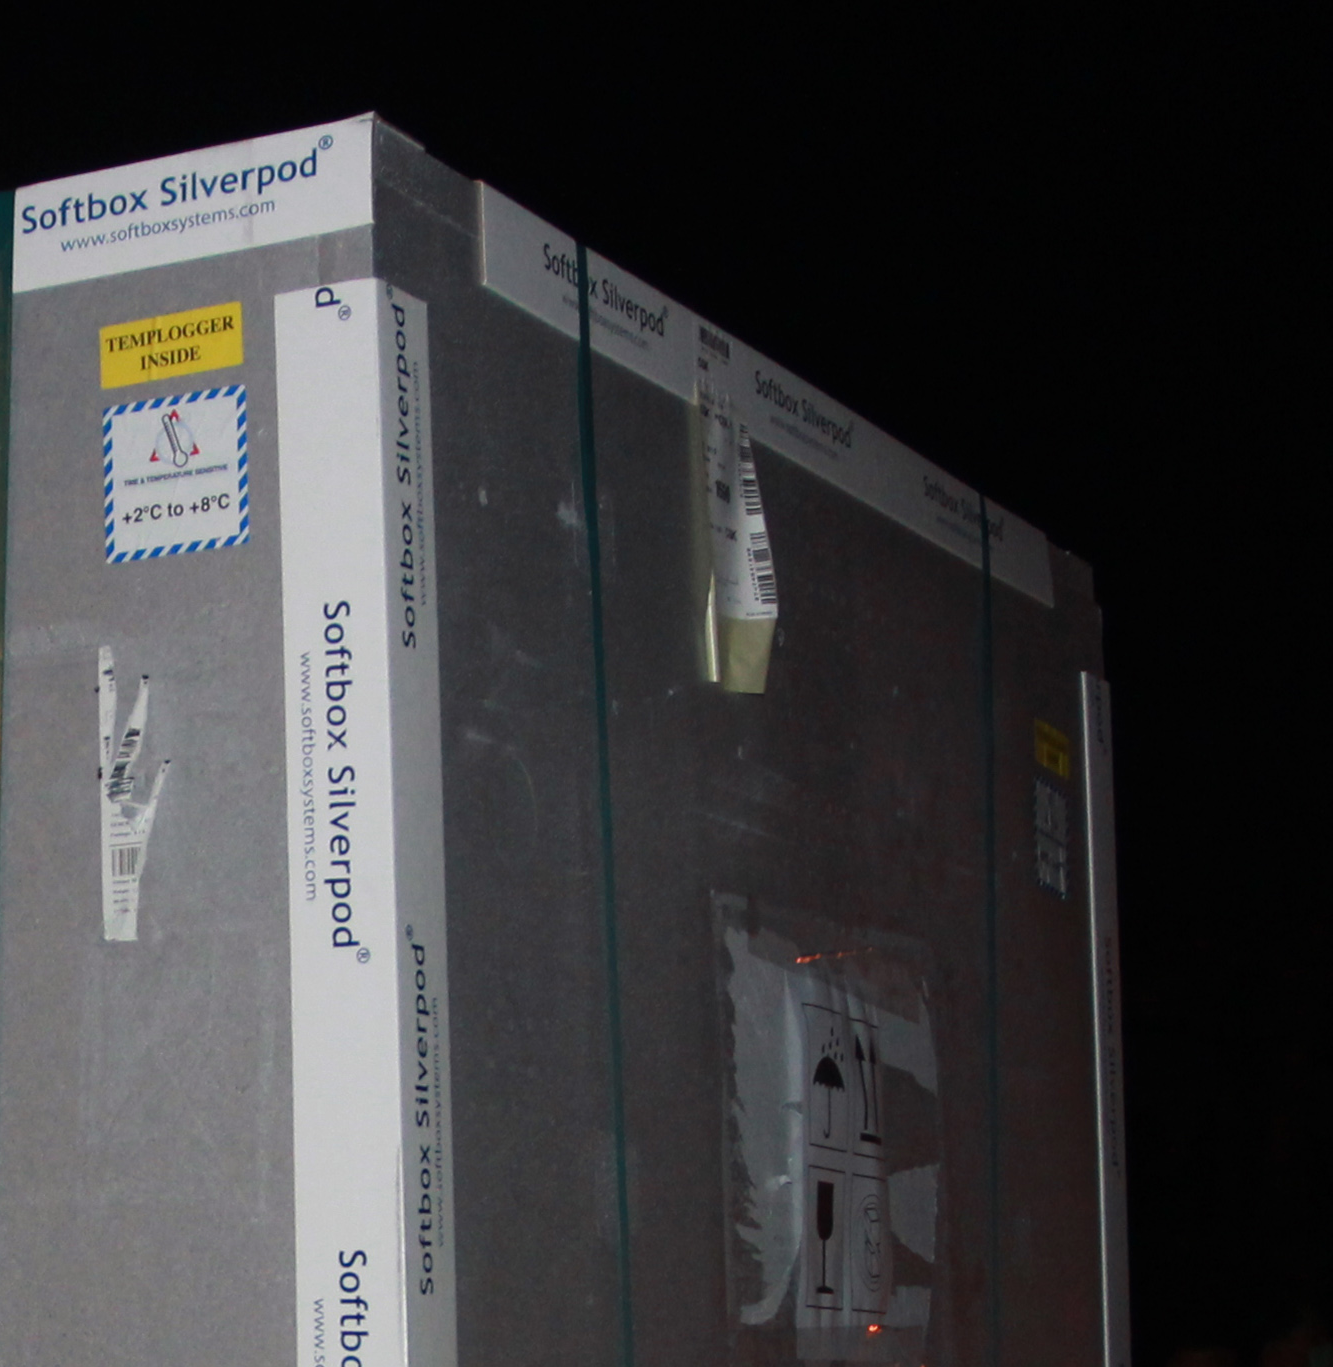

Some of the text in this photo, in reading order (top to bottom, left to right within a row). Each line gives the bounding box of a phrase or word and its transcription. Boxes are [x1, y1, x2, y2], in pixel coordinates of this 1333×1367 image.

[22, 189, 148, 234] Softbox
[60, 200, 276, 251] www.softboxsystems.com
[544, 243, 598, 299] Softbx
[105, 315, 235, 353] TEMPLOGGER
[140, 346, 201, 372] INSIDE
[755, 370, 799, 417] Softbox
[122, 493, 230, 524] +2°C to +8°C
[400, 500, 417, 649] Softbox
[324, 600, 354, 750] Softbox
[299, 652, 317, 901] www.softboxsystems.com
[418, 1145, 434, 1295] Softbox
